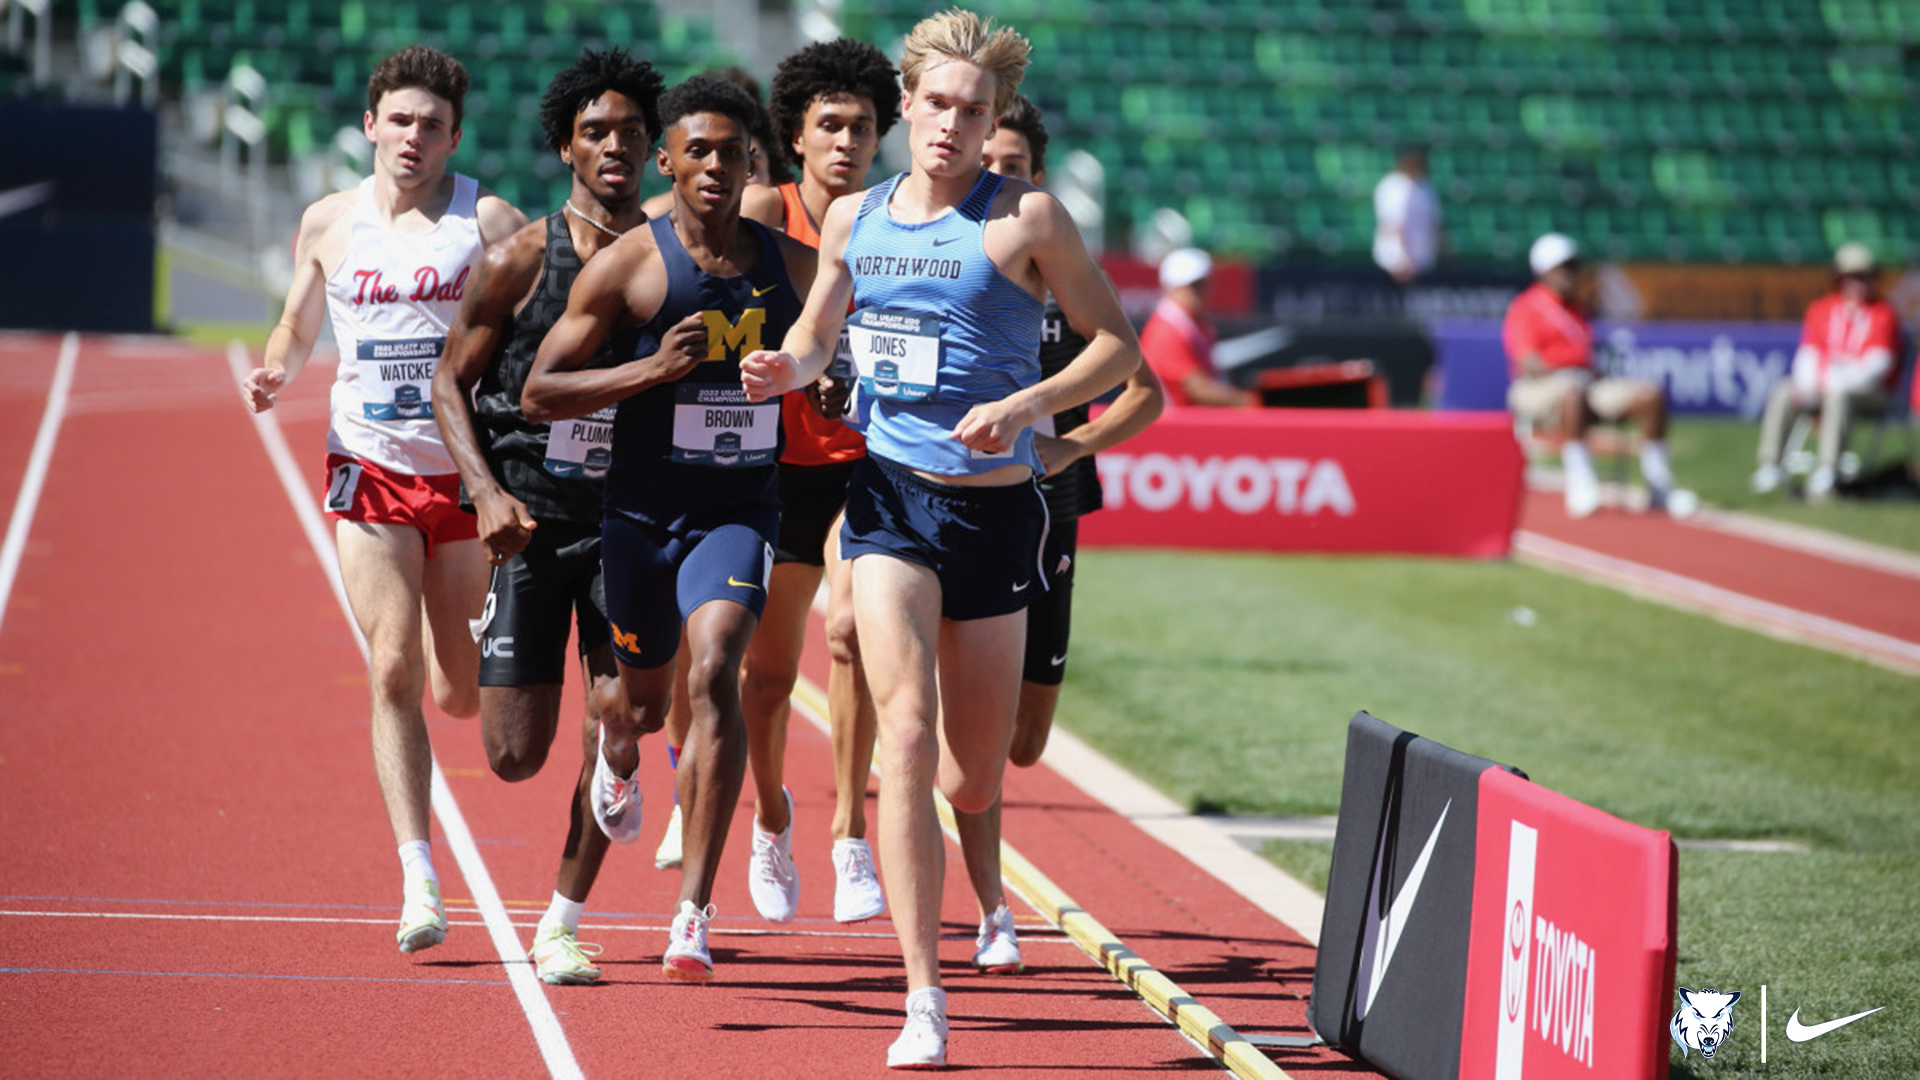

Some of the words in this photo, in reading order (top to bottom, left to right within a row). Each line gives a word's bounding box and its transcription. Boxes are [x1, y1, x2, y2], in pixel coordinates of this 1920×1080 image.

[855, 255, 962, 280] NORTHWOOD
[353, 268, 399, 305] The
[410, 265, 471, 302] Dal
[702, 308, 766, 362] M
[869, 334, 907, 358] JONES
[379, 362, 433, 381] WATCKE
[704, 409, 755, 428] BROWN
[329, 465, 351, 508] 2
[1095, 452, 1358, 517] TOYOTA
[482, 636, 515, 658] UC
[610, 621, 642, 654] M
[1531, 914, 1596, 1069] TOYOTA
